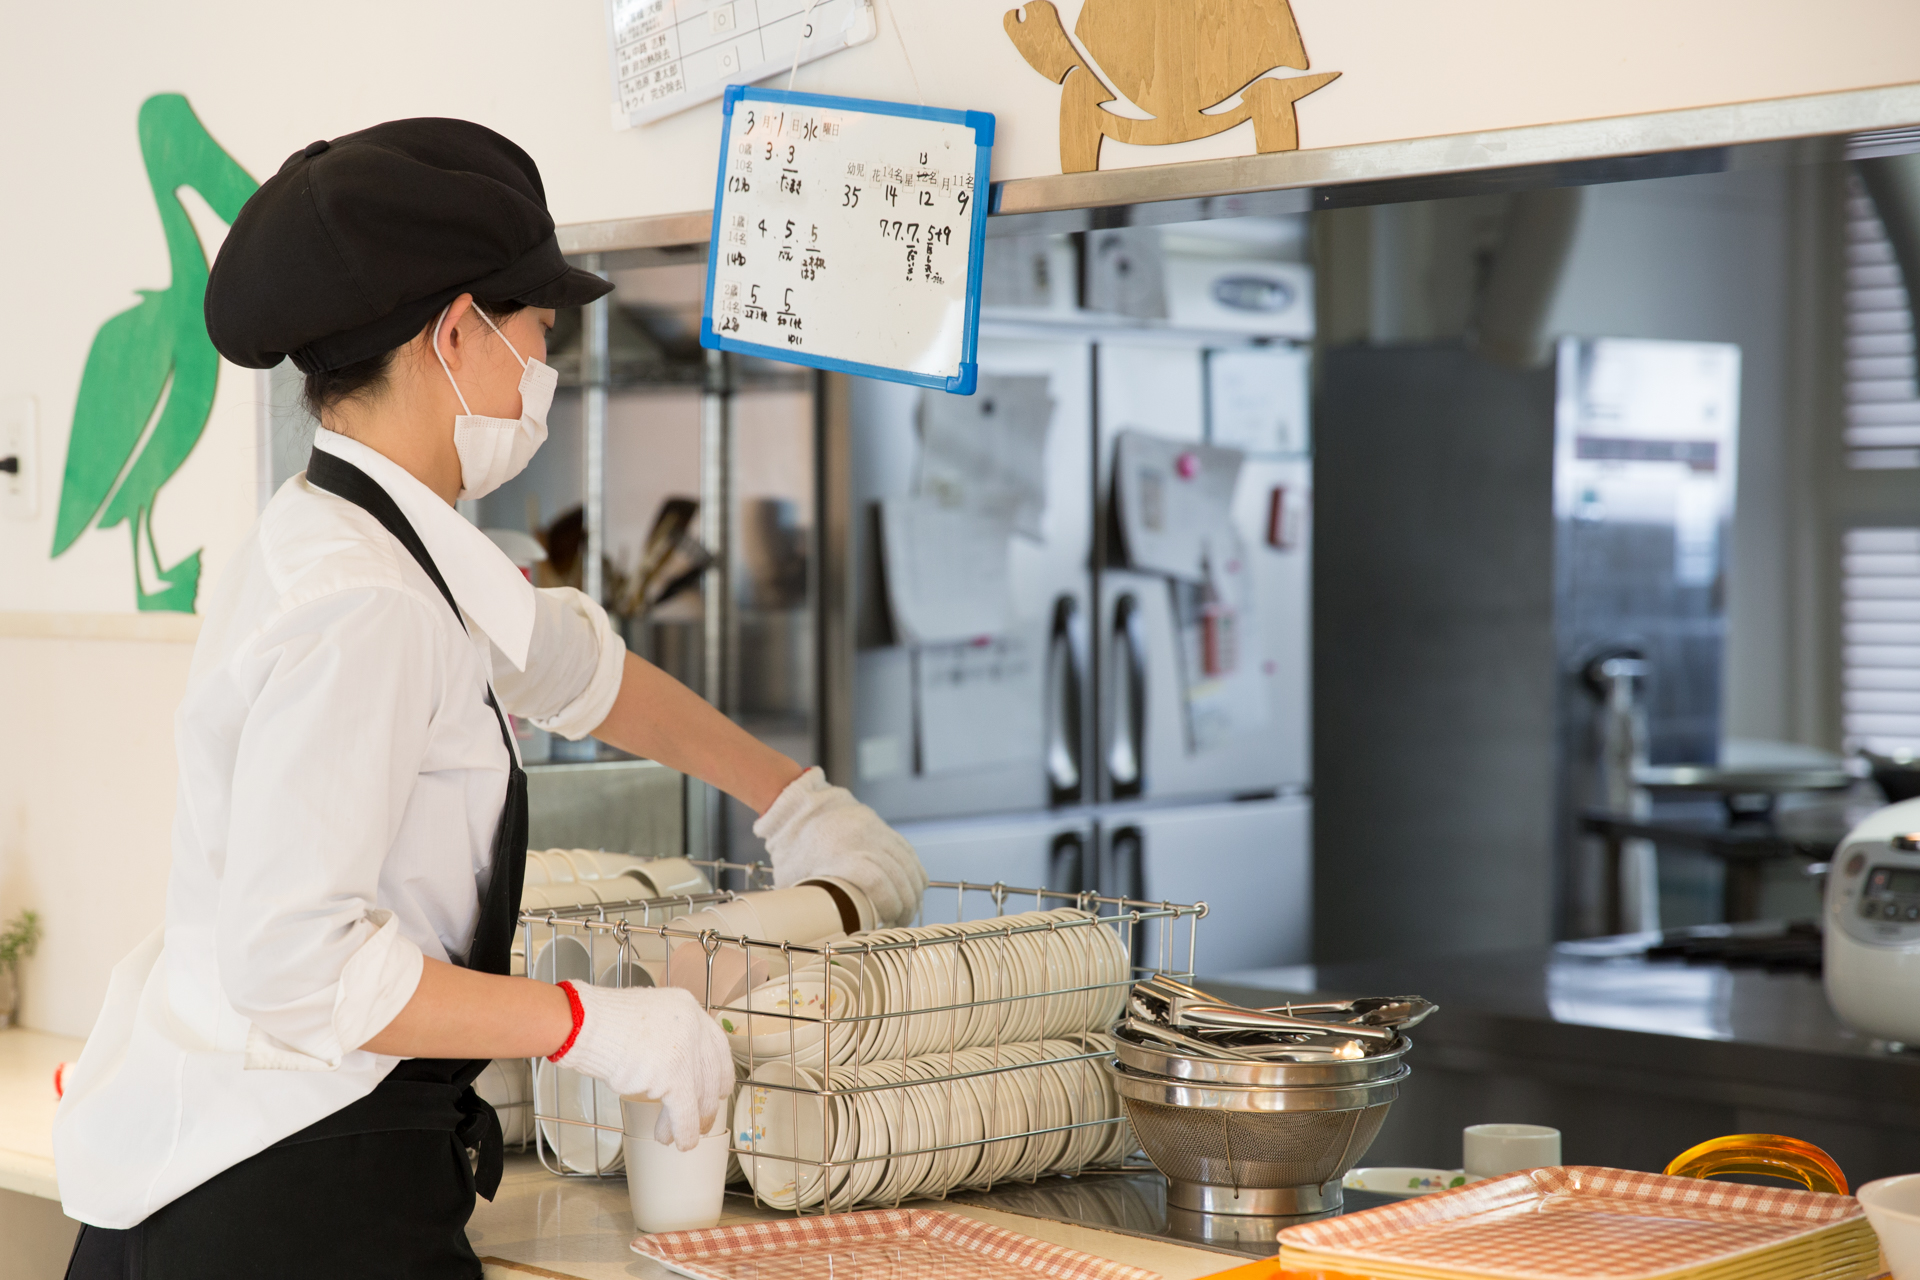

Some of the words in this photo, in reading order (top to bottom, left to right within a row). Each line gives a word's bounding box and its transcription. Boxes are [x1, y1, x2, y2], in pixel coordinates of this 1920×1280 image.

[846, 162, 865, 177] 幼児
[842, 184, 862, 208] 35
[885, 184, 898, 207] 14
[919, 190, 934, 206] 12
[957, 190, 970, 216] 9
[751, 284, 761, 305] 5
[784, 287, 794, 313] 5
